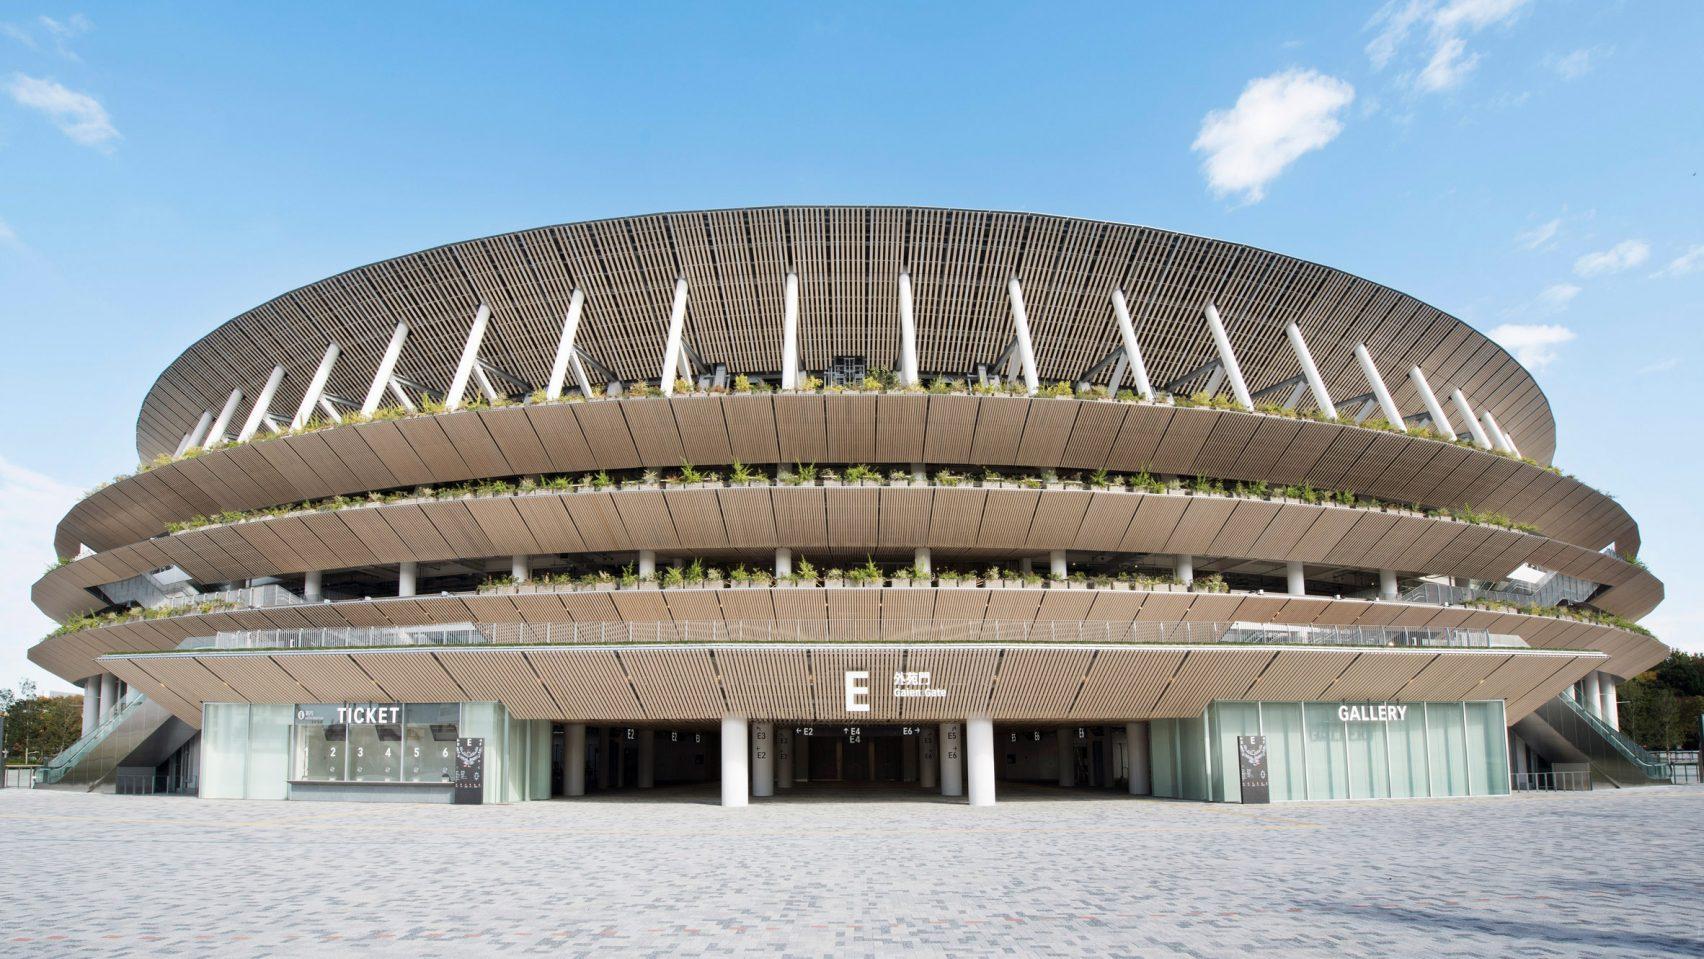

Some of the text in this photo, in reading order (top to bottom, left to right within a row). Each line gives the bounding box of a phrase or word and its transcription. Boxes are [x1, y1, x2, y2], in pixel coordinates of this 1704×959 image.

[894, 671, 931, 686] 外苑門
[845, 671, 870, 712] E
[894, 688, 947, 697] Gaien Gate
[337, 707, 399, 724] TICKET
[1338, 705, 1407, 721] GALLERY
[627, 728, 635, 740] E2
[757, 732, 766, 740] E3
[803, 727, 814, 736] E2
[850, 727, 861, 736] E4
[902, 727, 913, 735] E6
[467, 738, 473, 746] E
[330, 747, 336, 757] 2
[357, 747, 364, 757] 3
[385, 747, 392, 757] 4
[414, 747, 420, 757] 5
[442, 747, 448, 757] 6
